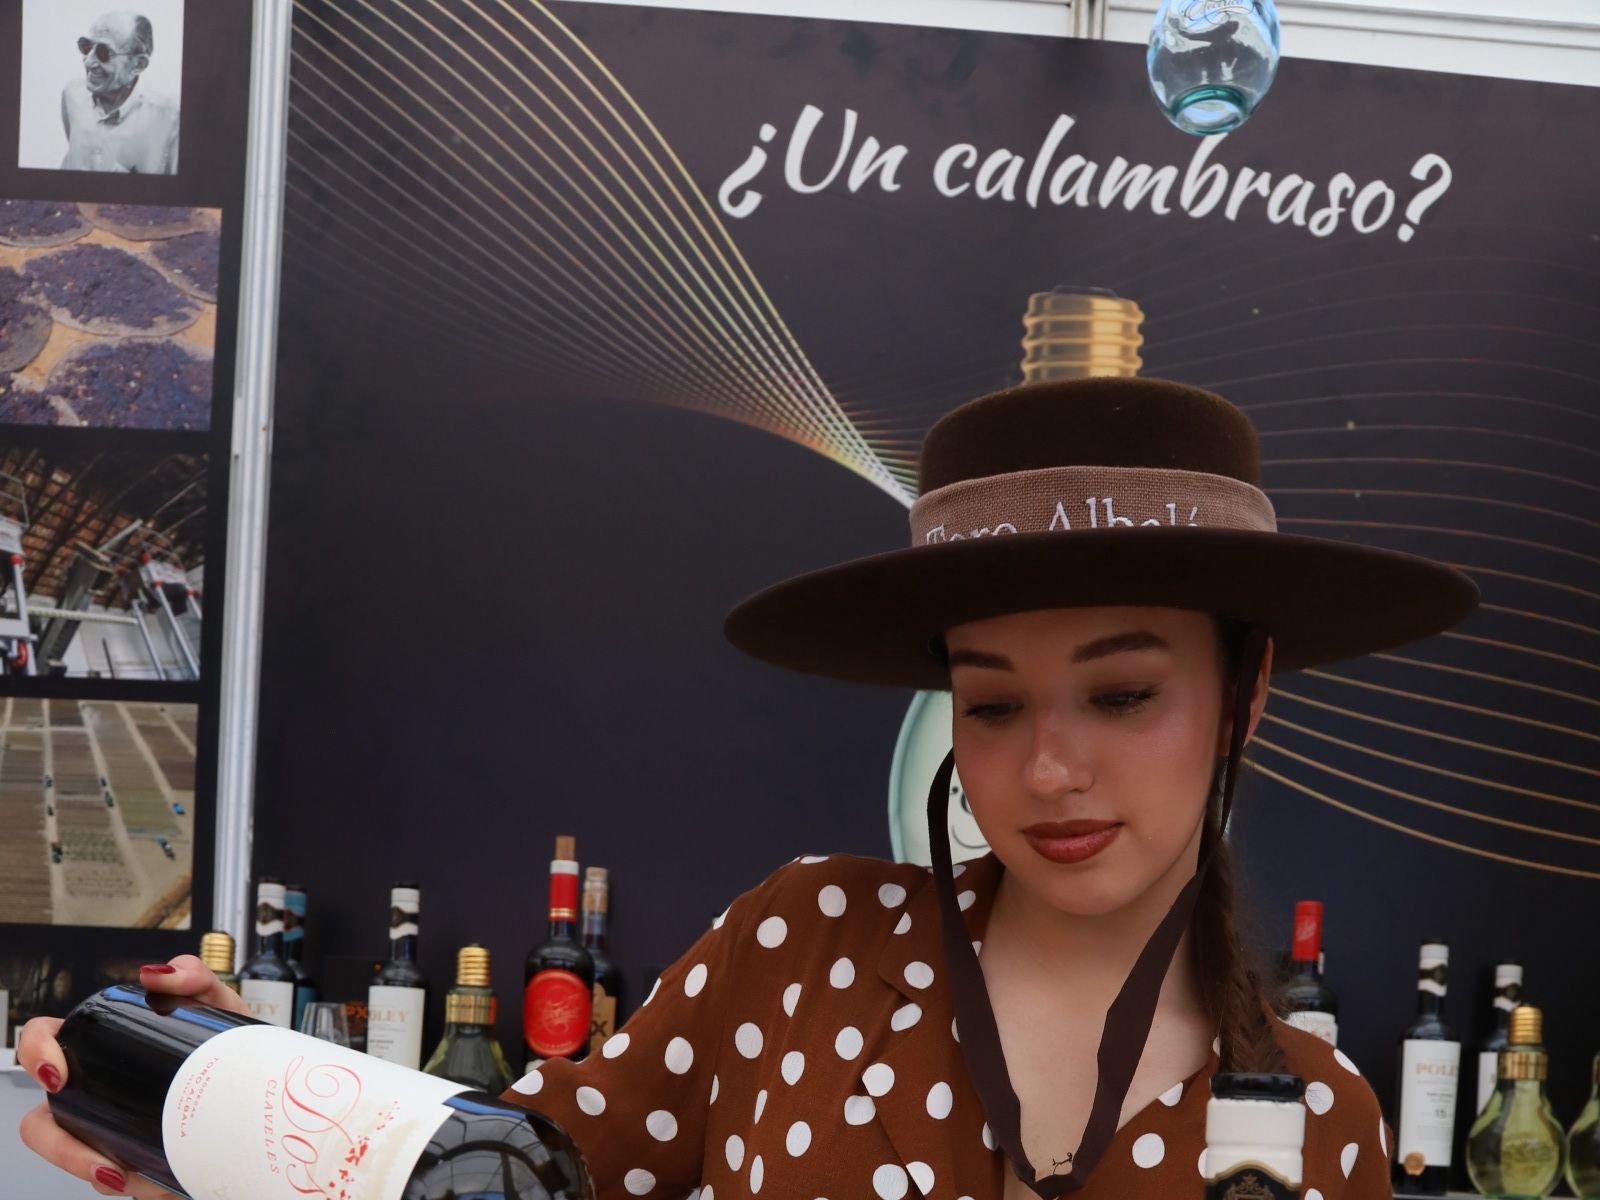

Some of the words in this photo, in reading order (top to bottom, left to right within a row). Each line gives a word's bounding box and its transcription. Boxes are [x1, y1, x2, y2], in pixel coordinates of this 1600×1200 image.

[718, 104, 908, 218] ¿Un
[933, 113, 1453, 242] calambraso?
[195, 1057, 219, 1084] TORO
[263, 1079, 280, 1174] CLAVELES
